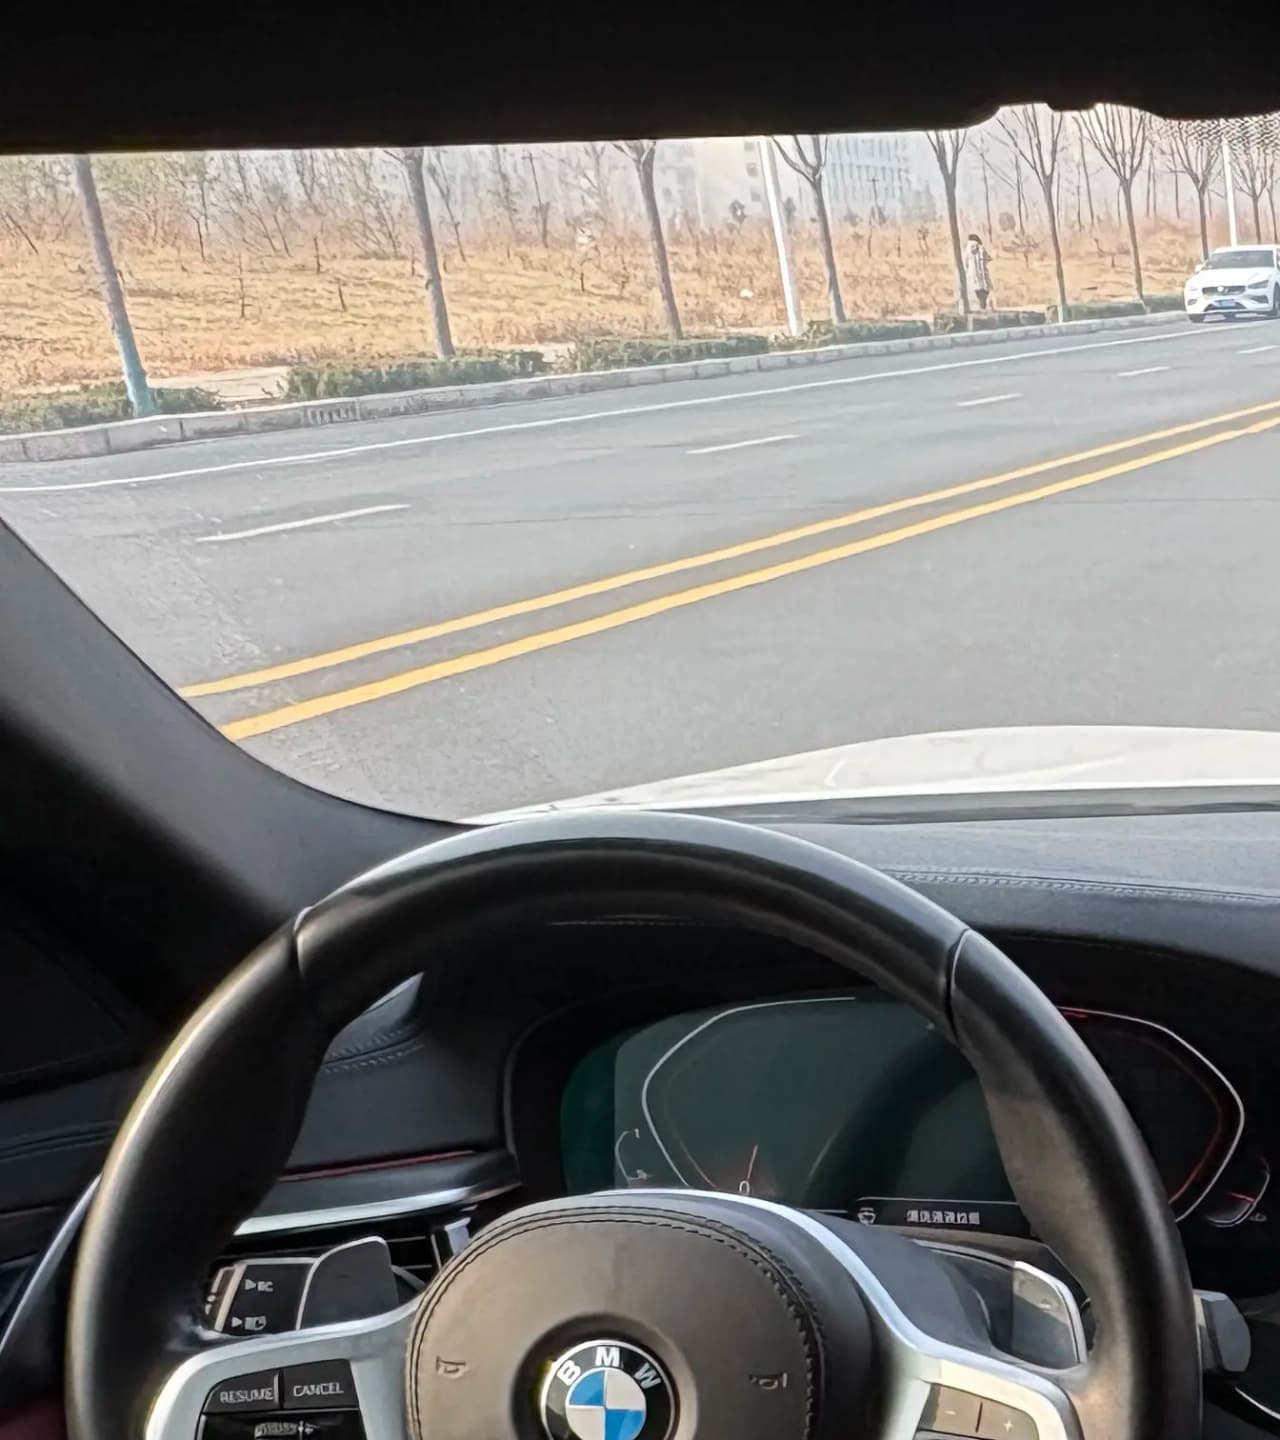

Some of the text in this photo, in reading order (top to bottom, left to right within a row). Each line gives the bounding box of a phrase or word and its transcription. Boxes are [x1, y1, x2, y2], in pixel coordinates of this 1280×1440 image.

[557, 1346, 661, 1390] BMW
[220, 1387, 274, 1403] RESUME
[292, 1381, 345, 1398] CANCEL
